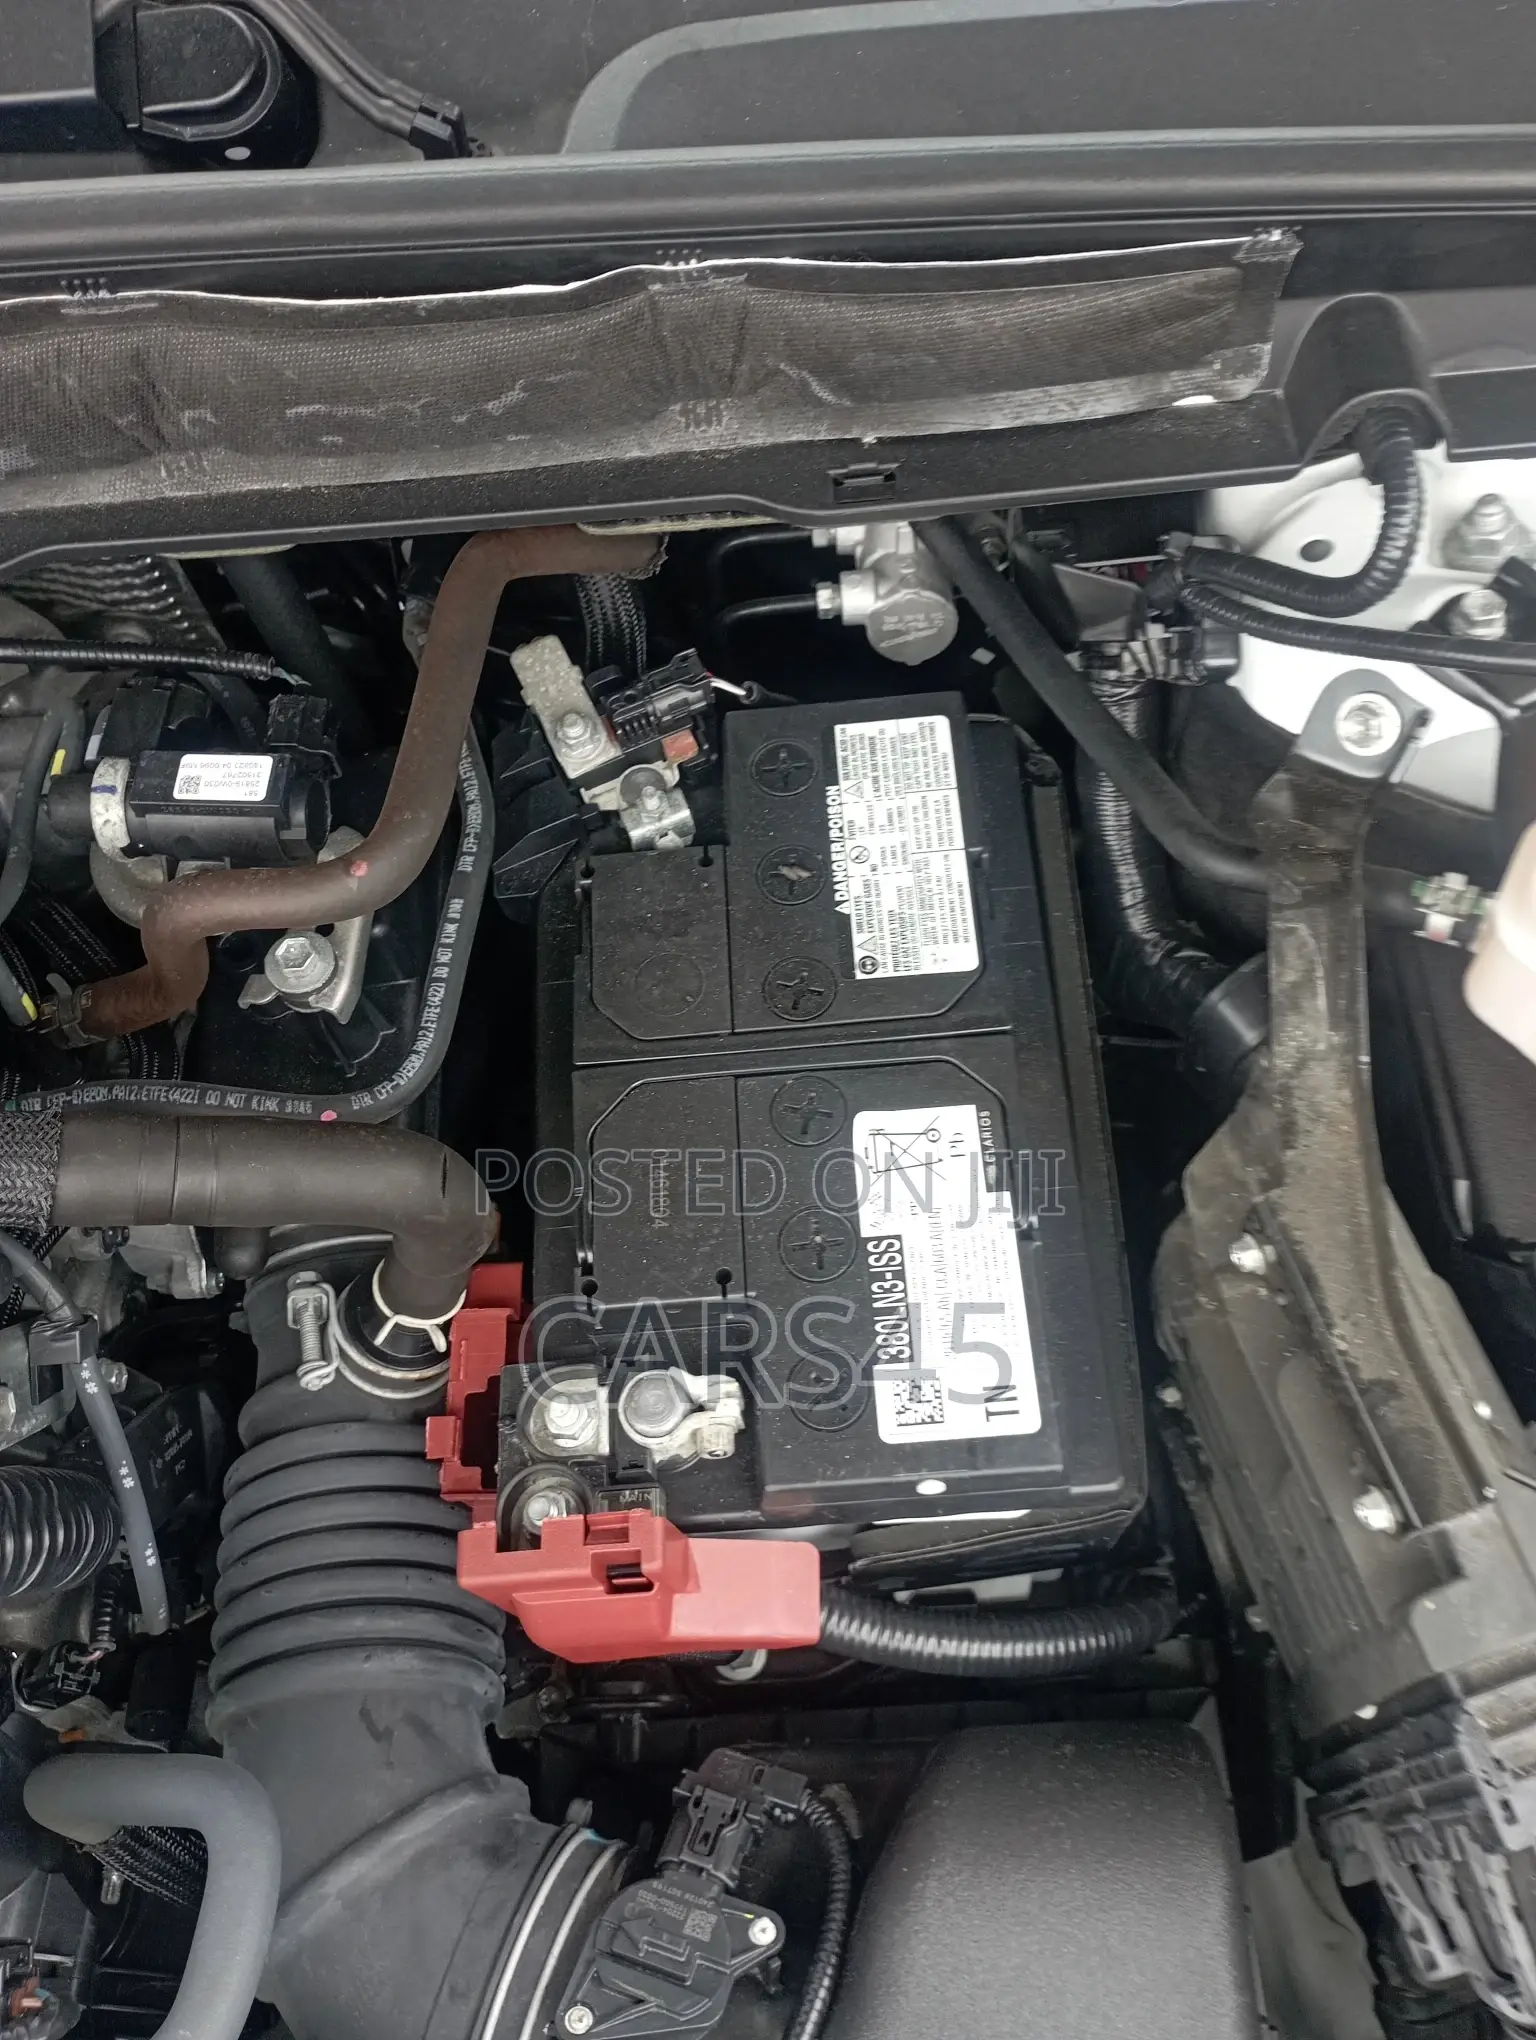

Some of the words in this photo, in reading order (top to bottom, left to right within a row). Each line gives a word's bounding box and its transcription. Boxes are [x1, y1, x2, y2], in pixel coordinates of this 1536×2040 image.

[826, 784, 850, 901] DANGER/POISON
[869, 863, 879, 872] NO
[864, 900, 875, 933] EXPLOSIVE
[436, 948, 453, 965] NOT
[432, 965, 449, 979] DO
[205, 1090, 220, 1106] DO
[223, 1091, 247, 1108] NOT
[948, 1132, 966, 1158] Pb
[979, 1110, 996, 1163] CLARIOS
[866, 1238, 912, 1360] 380LN3-ISS
[983, 1384, 1020, 1422] TN
